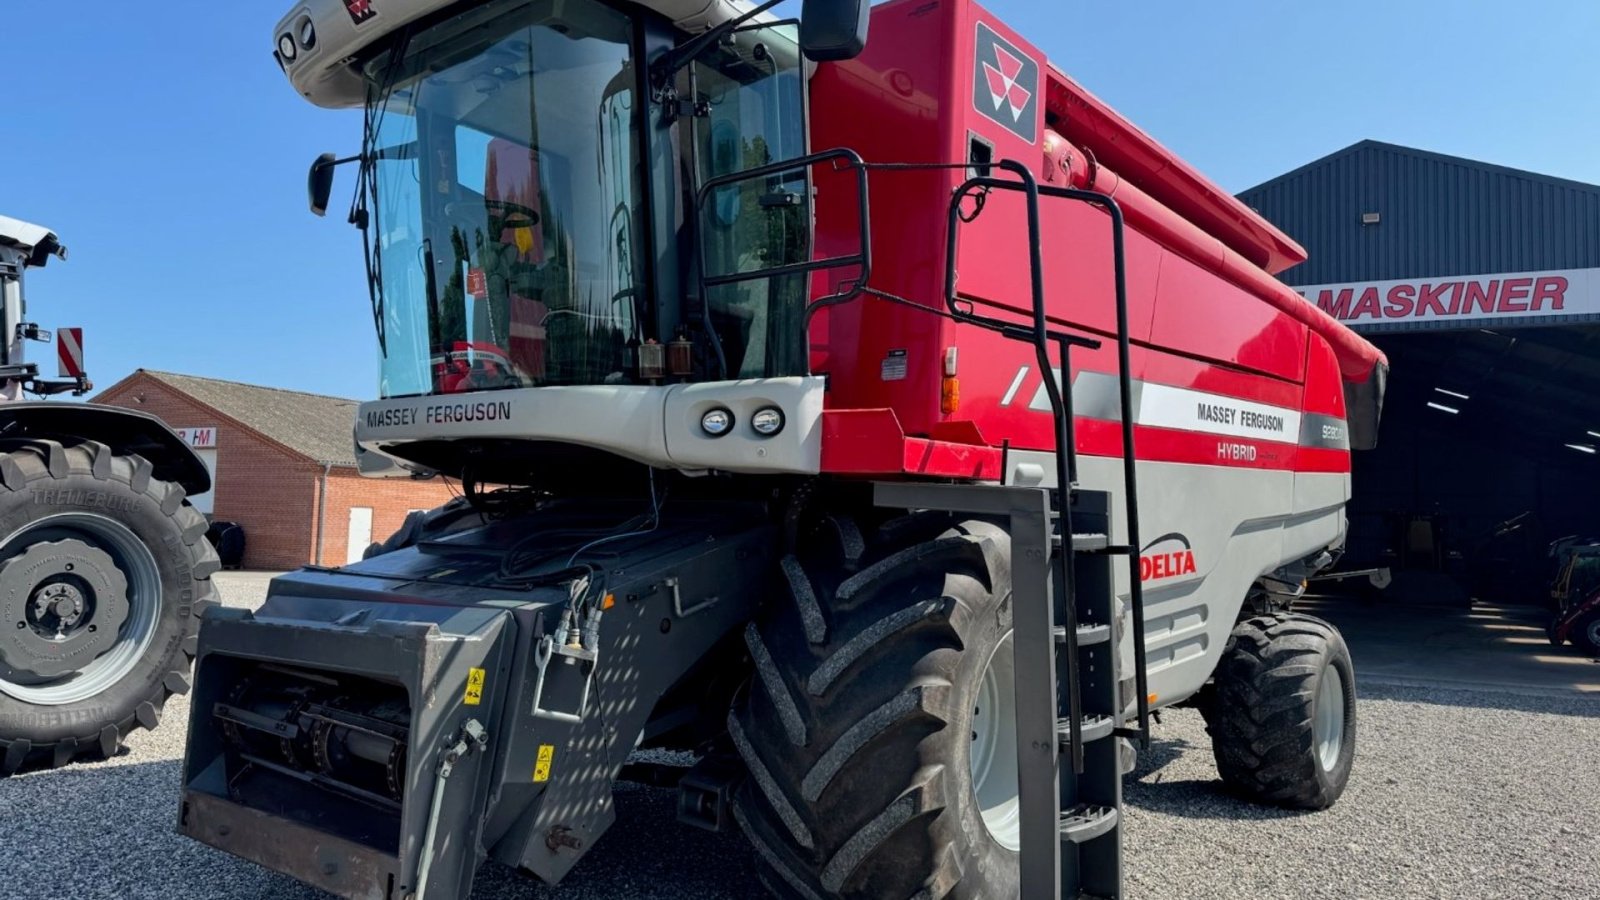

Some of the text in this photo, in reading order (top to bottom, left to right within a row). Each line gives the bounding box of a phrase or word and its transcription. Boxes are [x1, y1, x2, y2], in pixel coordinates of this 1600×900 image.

[1316, 276, 1569, 321] MASKINER
[367, 401, 511, 428] MASSEY FERGUSON
[1197, 403, 1284, 432] MASSEY FERGUSON
[1217, 442, 1257, 461] HYBRID
[1139, 550, 1197, 581] DELTA
